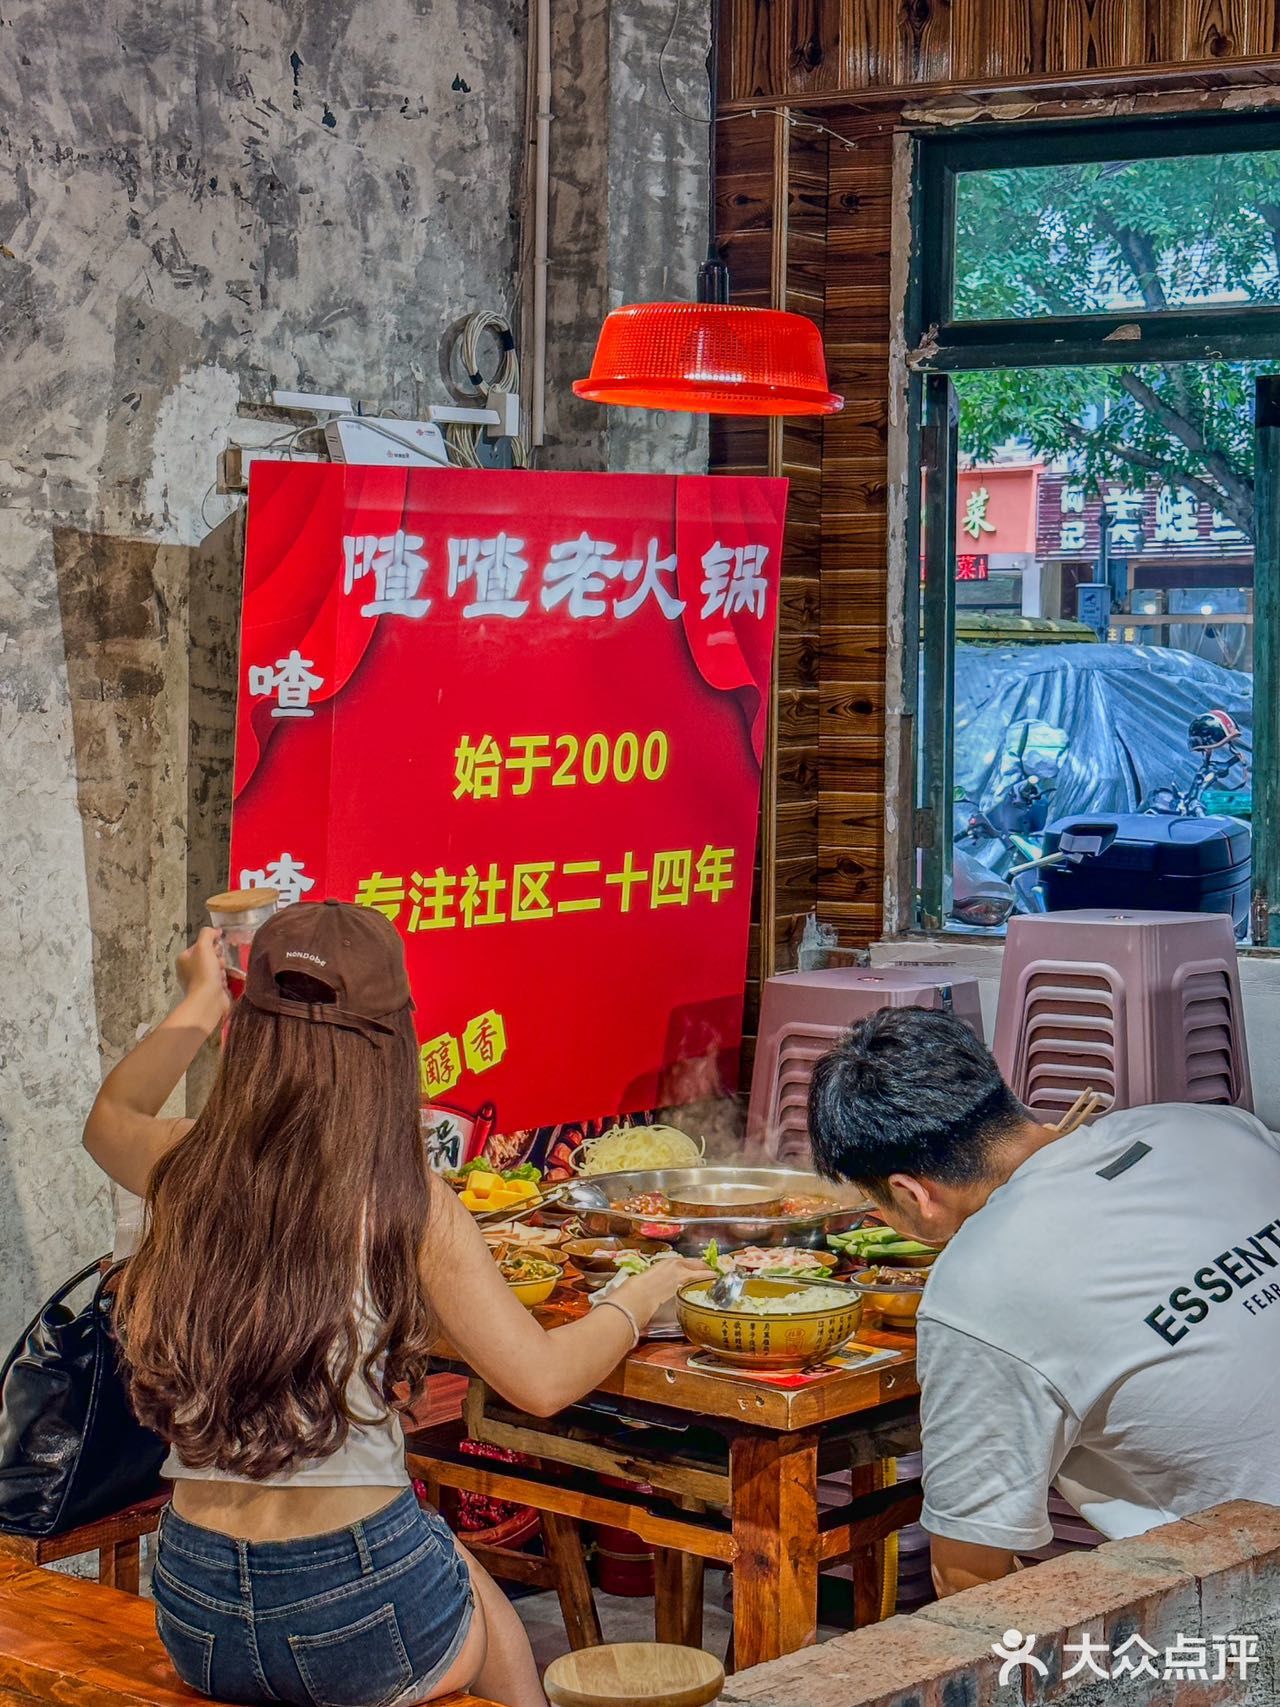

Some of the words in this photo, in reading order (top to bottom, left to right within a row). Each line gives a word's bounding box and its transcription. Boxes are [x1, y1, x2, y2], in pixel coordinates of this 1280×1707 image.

[962, 487, 996, 539] 菜
[453, 730, 669, 800] 始于2000
[354, 844, 736, 933] 专注社区二十四年
[1144, 1219, 1280, 1347] ESSENT
